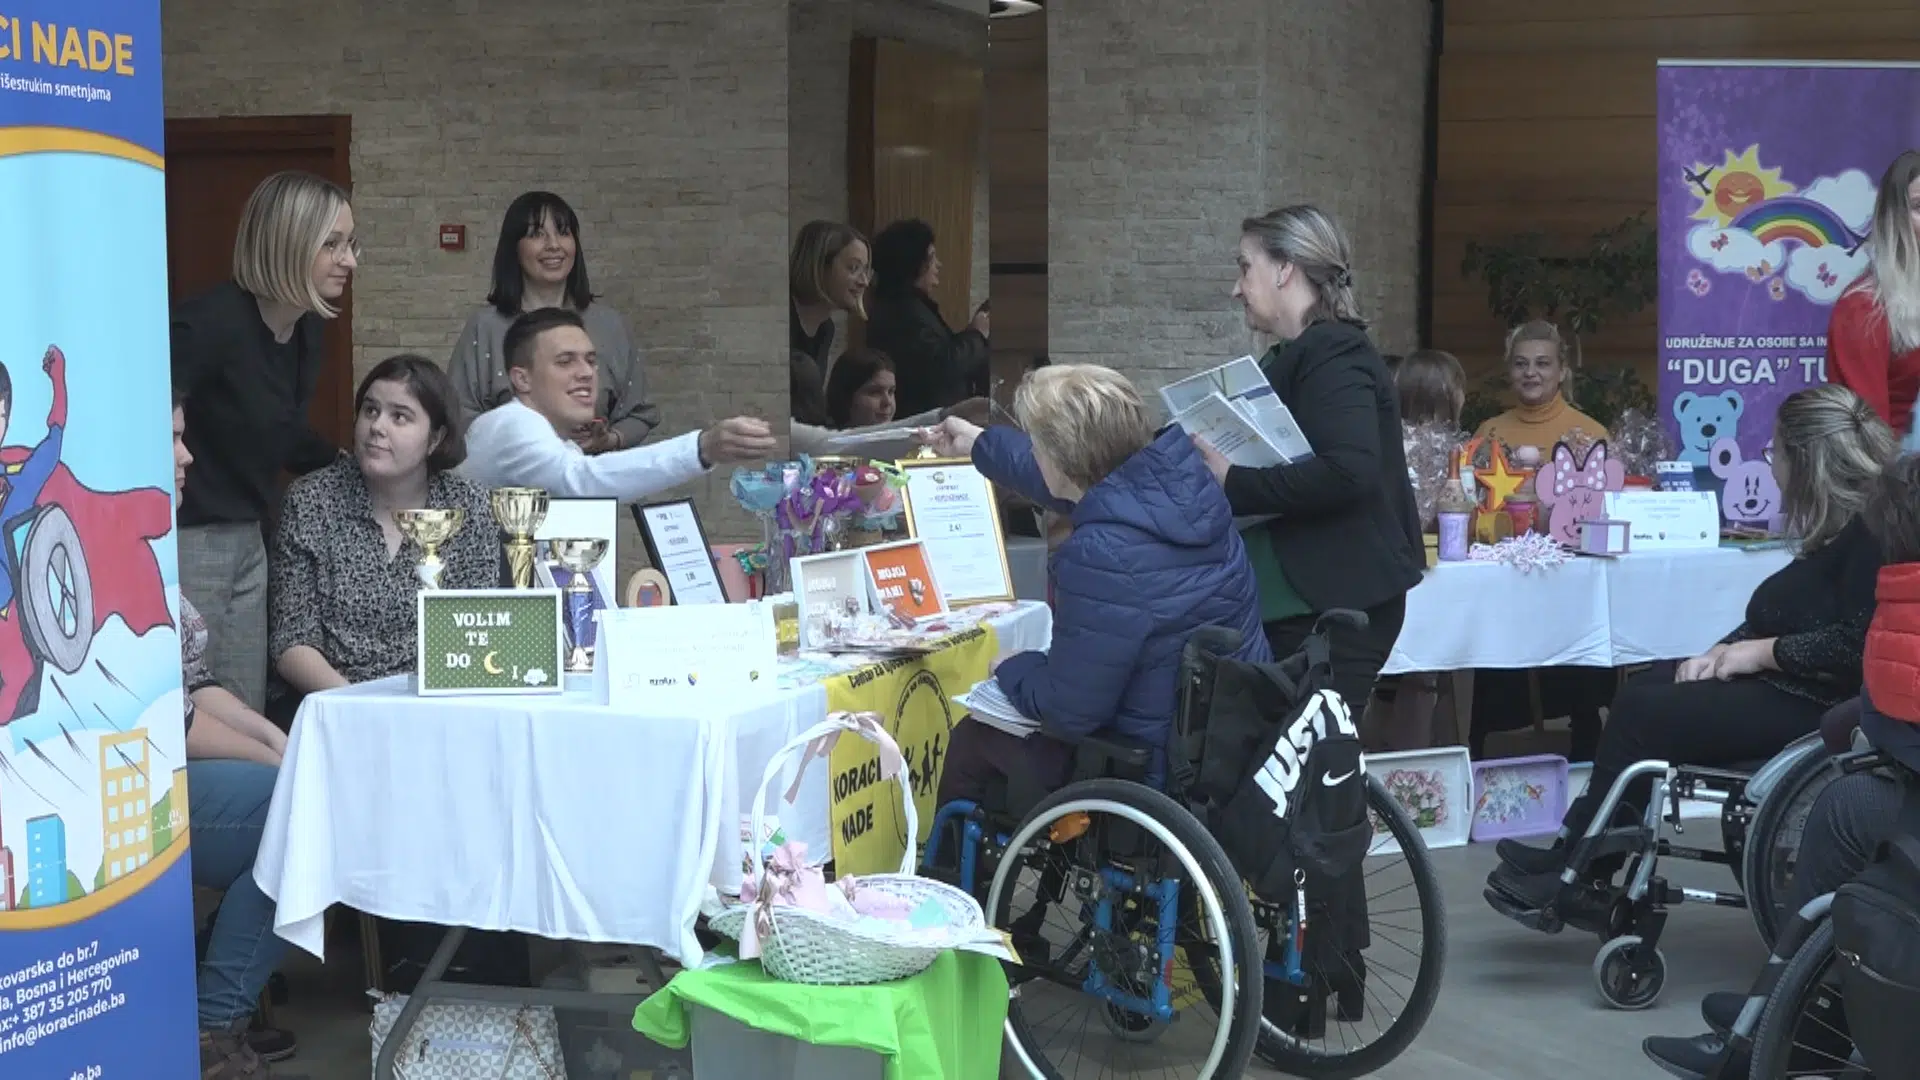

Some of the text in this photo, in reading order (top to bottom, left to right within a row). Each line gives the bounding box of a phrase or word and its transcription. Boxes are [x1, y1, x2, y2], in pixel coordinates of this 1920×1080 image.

[32, 20, 134, 76] NADE
[55, 81, 111, 102] smetnjama
[1665, 334, 1734, 348] UDRUŽENJE
[1738, 337, 1754, 348] ZA
[1757, 337, 1797, 348] OSOBE
[1800, 337, 1815, 347] SA
[452, 611, 512, 627] VOLIM
[465, 631, 489, 646] TE
[446, 653, 471, 668] DO
[1253, 693, 1327, 819] JUST
[833, 756, 882, 804] KORACI
[842, 803, 873, 846] NADE
[17, 980, 56, 1005] Bosna
[60, 973, 64, 988] i
[67, 947, 139, 987] Hercegovina
[57, 952, 74, 969] do
[77, 940, 98, 963] br.7
[22, 1001, 46, 1025] 387
[49, 995, 64, 1013] 35
[67, 986, 89, 1007] 205
[92, 976, 112, 997] 770
[0, 992, 125, 1055] info@koracinade.ba
